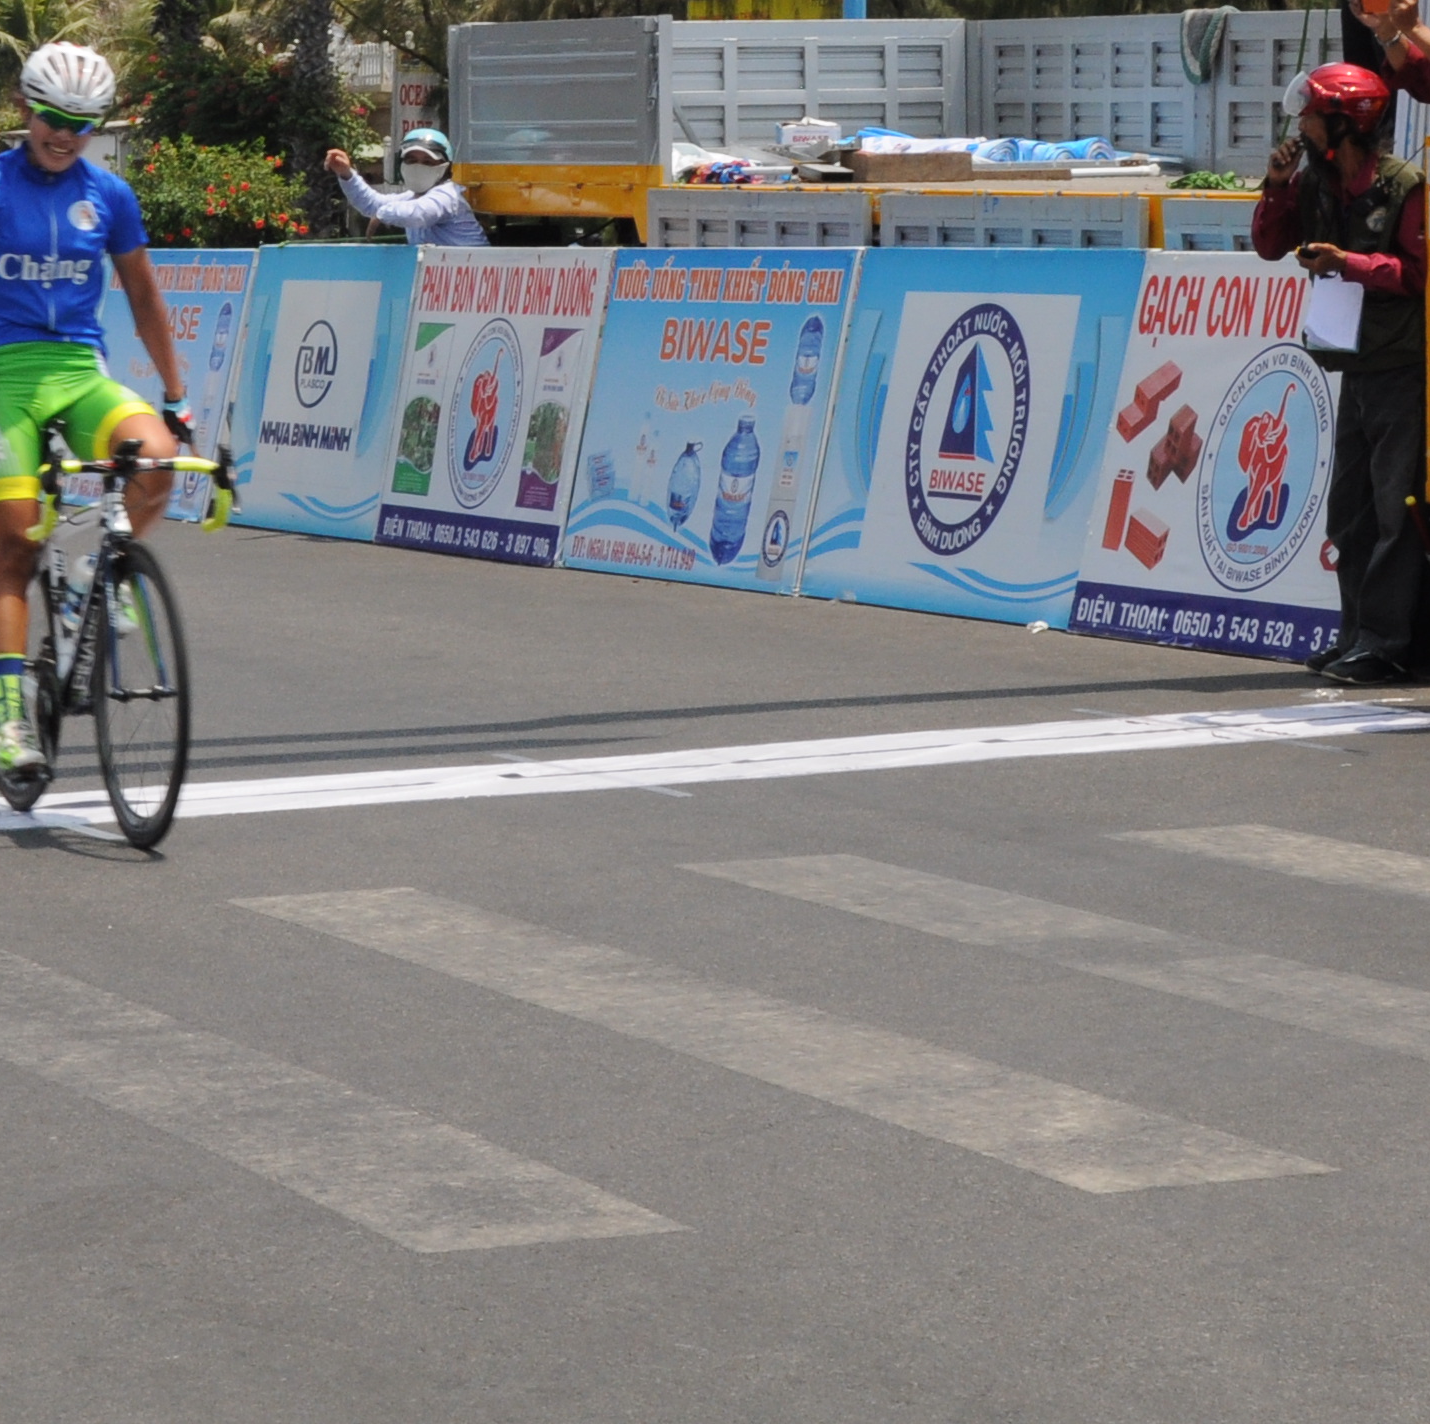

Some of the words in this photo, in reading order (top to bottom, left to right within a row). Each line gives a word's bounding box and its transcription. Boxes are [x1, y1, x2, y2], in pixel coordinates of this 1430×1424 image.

[419, 252, 453, 312] PHÂN
[451, 253, 480, 313] BÓN
[476, 266, 504, 314] CON
[502, 266, 525, 315] VOI
[522, 254, 556, 316] BÌNH
[650, 255, 687, 303] UỐNG
[687, 267, 723, 303] TINH
[722, 256, 768, 304] KHIẾT
[765, 260, 807, 305] ĐÓNG
[806, 268, 845, 305] CHAI
[168, 305, 203, 341] ASE
[973, 310, 1009, 339] NƯỚC
[1137, 274, 1200, 348] GẠCH
[1206, 276, 1257, 339] CON
[1260, 276, 1308, 338] VOI
[659, 317, 772, 365] BIWASE
[930, 317, 972, 377] THOÁT
[1008, 341, 1028, 385] MÔI
[1247, 358, 1270, 383] CON
[1272, 352, 1289, 367] VOI
[913, 383, 932, 433] CẤP
[908, 441, 920, 488] CTY
[995, 389, 1028, 495] TRƯỜNG
[928, 469, 986, 494] BIWASE
[382, 514, 404, 541] ĐIỆN
[505, 533, 512, 553] 3
[1226, 564, 1264, 584] BIWASE
[1075, 593, 1116, 628] ĐIỆN
[1172, 609, 1226, 640] 0650.3
[1228, 616, 1259, 644] 543
[1262, 620, 1295, 649] 528
[1310, 626, 1323, 652] 3
